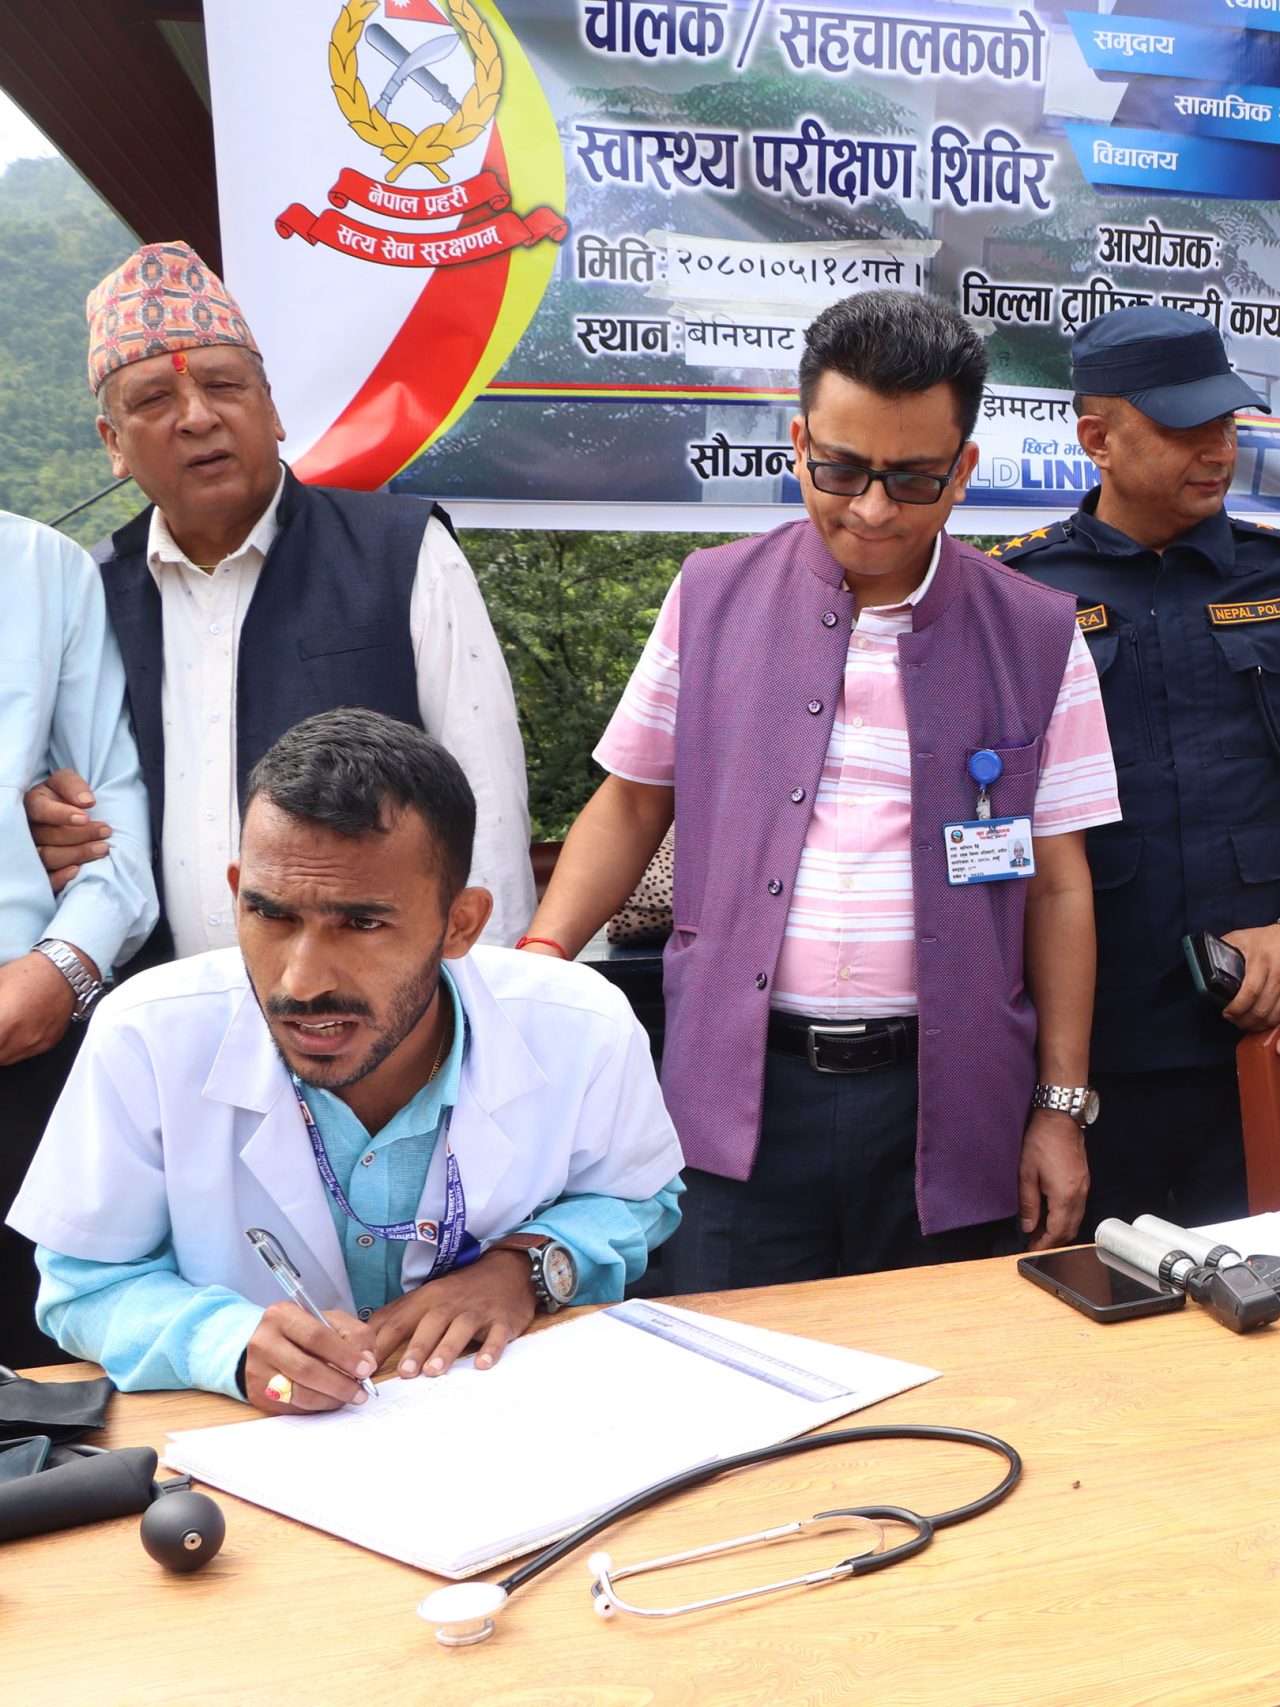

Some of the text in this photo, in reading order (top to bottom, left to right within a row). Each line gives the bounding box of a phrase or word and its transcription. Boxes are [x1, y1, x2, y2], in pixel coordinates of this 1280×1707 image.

[780, 8, 1046, 81] सहचालकको
[1093, 30, 1176, 56] समुदाय
[1174, 94, 1273, 123] सामाजिक
[576, 118, 1054, 210] स्वास्थ्य परीक्षण शिविर
[1093, 141, 1179, 171] विद्यालय
[368, 184, 469, 215] नेपाल प्रहरी
[336, 223, 503, 264] सत्य सेवा सुरक्षणम्
[963, 271, 1054, 323] जिल्ला
[1215, 607, 1256, 621] NEPAL
